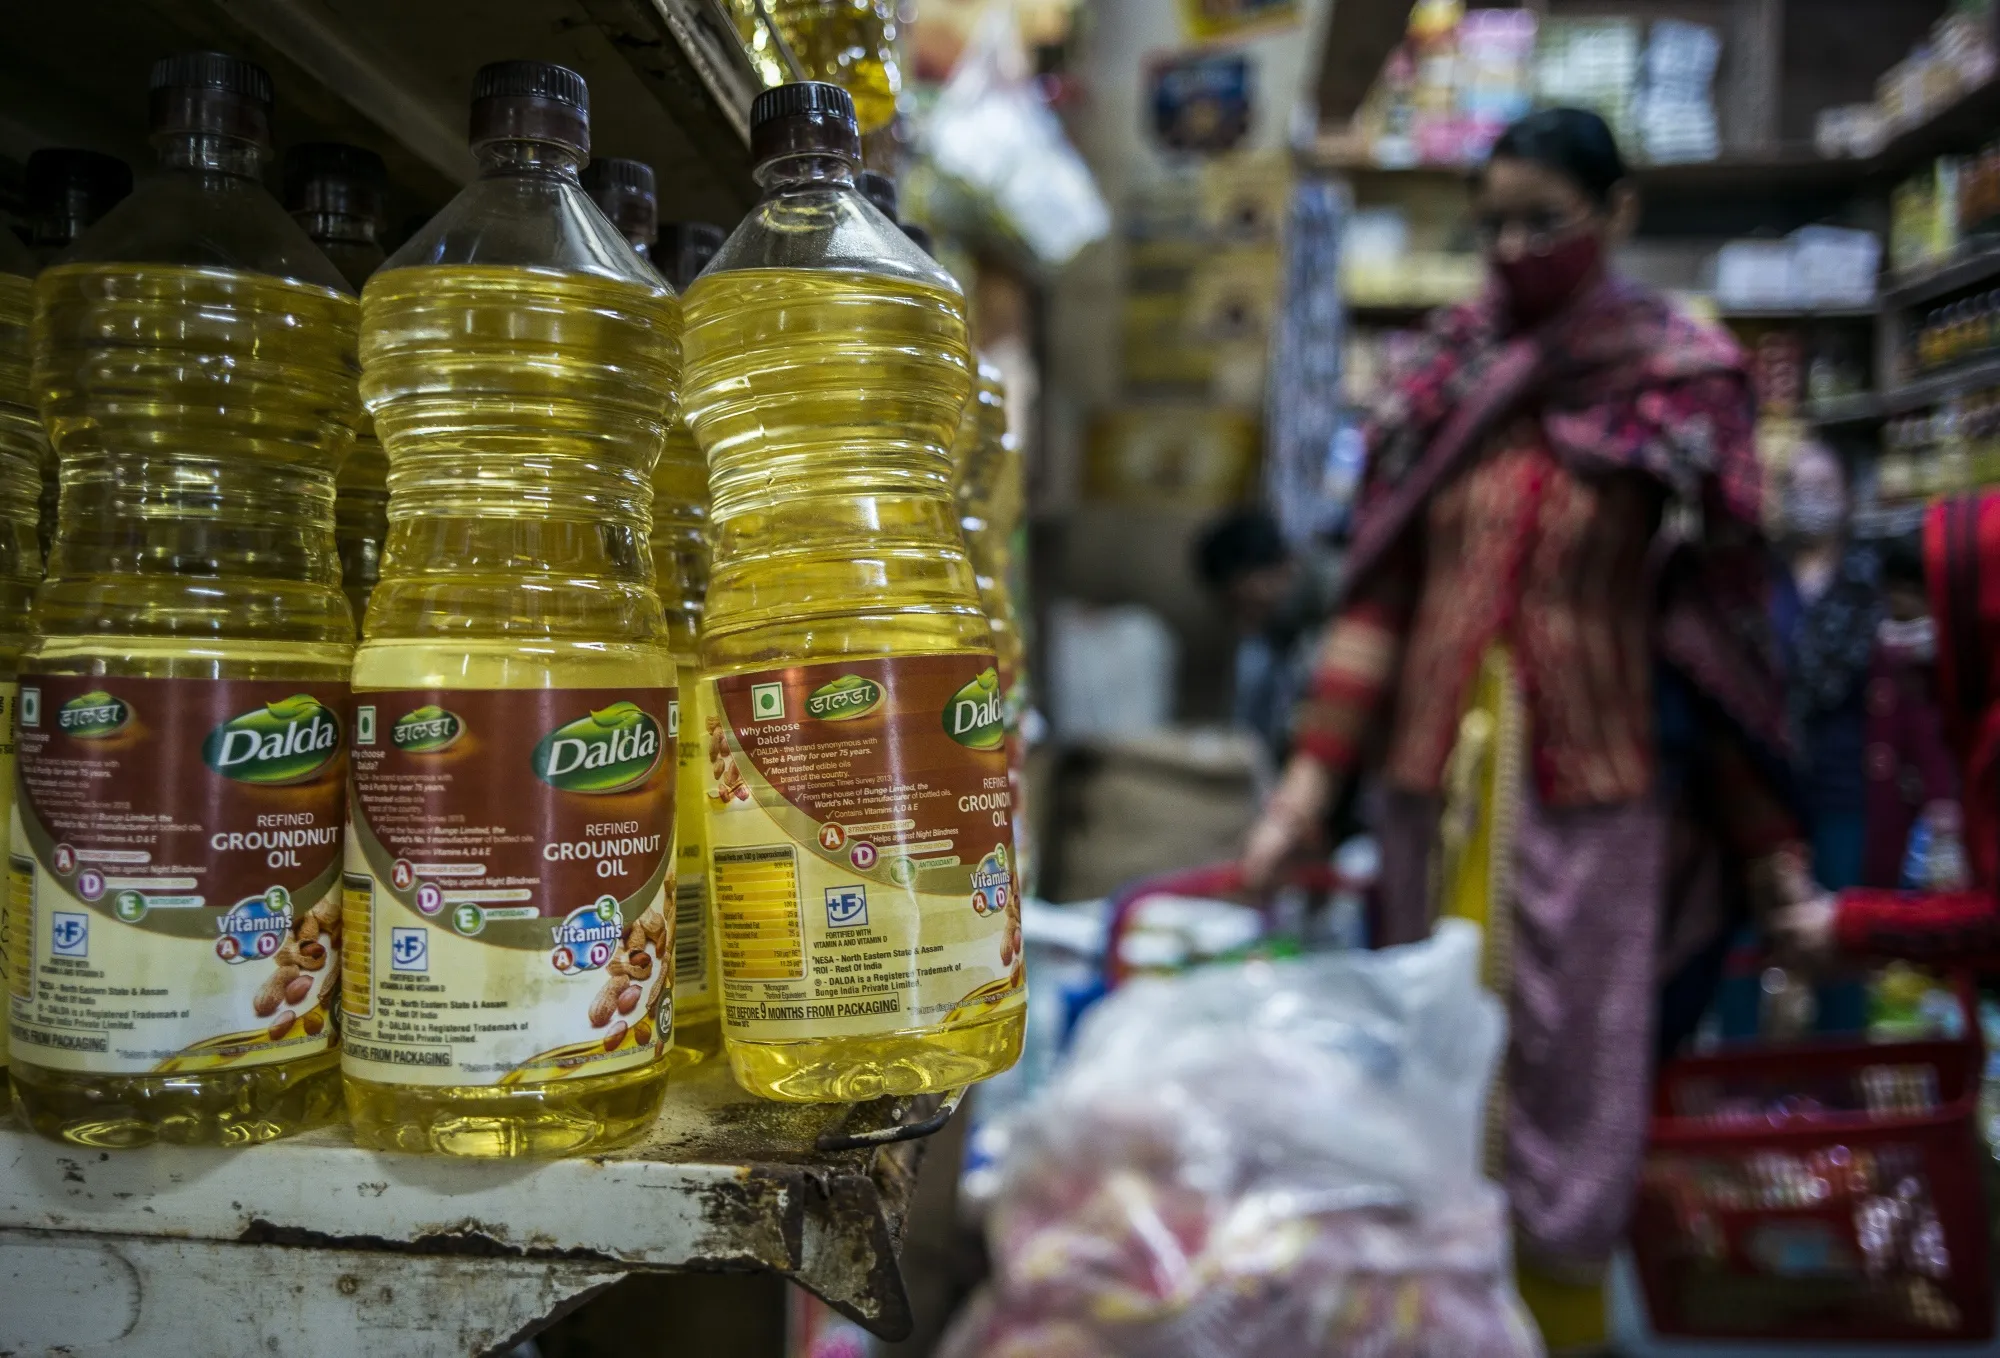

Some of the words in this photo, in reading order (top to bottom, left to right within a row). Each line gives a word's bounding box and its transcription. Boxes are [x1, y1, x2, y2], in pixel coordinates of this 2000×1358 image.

[810, 685, 872, 714] डालडा
[60, 704, 120, 727] डालडा
[394, 718, 452, 743] डालडा
[740, 727, 761, 737] Why
[763, 722, 800, 735] choose
[217, 715, 333, 766] Dalda
[757, 733, 791, 746] Dalda?
[757, 747, 778, 756] DALDA
[783, 745, 795, 753] the
[795, 743, 816, 752] brand
[817, 740, 861, 751] synonymous
[547, 723, 655, 776] Dalda
[762, 756, 779, 765] Taste
[780, 755, 786, 763] &
[787, 753, 807, 762] Purity
[809, 752, 819, 760] for
[821, 751, 837, 759] over
[839, 749, 848, 757] 75
[849, 747, 872, 758] years.
[771, 766, 787, 775] Most
[789, 765, 815, 773] trusted
[816, 762, 837, 770] edible
[838, 760, 851, 768] oils
[781, 775, 799, 784] brand
[822, 770, 850, 780] country.
[807, 780, 836, 790] Economic
[836, 779, 854, 787] Times
[855, 776, 876, 786] Survey
[803, 792, 820, 801] From
[821, 792, 833, 800] the
[833, 790, 855, 799] house
[855, 788, 863, 796] of
[864, 787, 887, 797] Bunge
[814, 799, 841, 809] World's
[843, 798, 855, 807] No.
[862, 794, 910, 804] manufacturer
[911, 792, 919, 800] of
[919, 790, 940, 799] bottled
[941, 789, 952, 797] oils.
[257, 812, 314, 827] REFINED
[834, 809, 863, 818] Contains
[864, 806, 892, 816] Vitamins
[992, 811, 1008, 828] OIL
[585, 821, 639, 837] REFINED
[825, 827, 841, 846] A
[848, 824, 881, 834] STRONGER
[916, 829, 932, 839] Night
[933, 828, 959, 837] Blindness
[211, 826, 338, 851] GROUNDNUT
[543, 834, 661, 862] GROUNDNUT
[853, 846, 873, 865] D
[58, 853, 73, 869] A
[267, 850, 302, 869] OIL
[597, 859, 628, 877] OIL
[919, 858, 954, 868] ANTIOXIDANT
[396, 864, 410, 884] A
[970, 869, 1010, 890] Vitamins
[82, 874, 99, 893] D
[119, 896, 137, 915] E
[270, 892, 281, 906] E
[420, 888, 438, 908] D
[975, 895, 985, 909] A
[998, 890, 1005, 904] D
[601, 901, 612, 916] E
[216, 914, 293, 934] Vitamins
[457, 908, 474, 928] E
[551, 922, 622, 944] Vitamins
[825, 929, 855, 939] FORTIFIED
[856, 928, 872, 937] WITH
[221, 942, 234, 956] A
[262, 935, 276, 951] D
[813, 941, 837, 949] VITAMIN
[844, 939, 856, 947] AND
[857, 937, 881, 946] VITAMIN
[557, 953, 570, 967] A
[595, 944, 606, 960] D
[841, 954, 862, 963] North
[864, 951, 892, 961] Eastern
[921, 945, 944, 954] Assam
[829, 976, 855, 986] DALDA
[857, 974, 865, 983] is
[917, 964, 953, 976] Trademark
[954, 962, 962, 972] of
[835, 964, 852, 973] Rest
[854, 963, 862, 971] Of
[863, 961, 882, 970] India
[815, 988, 838, 997] Bunge
[840, 985, 859, 994] India
[862, 983, 889, 992] Private
[450, 1000, 470, 1009] State
[737, 1006, 760, 1018] BEFORE
[760, 1002, 766, 1019] 9
[768, 1006, 804, 1019] MONTHS
[806, 1005, 835, 1018] FROM
[837, 998, 898, 1017] PACKAGING
[428, 1022, 471, 1033] Registered
[473, 1022, 518, 1032] Trademark
[520, 1021, 529, 1031] of
[52, 1032, 107, 1051] PACKAGING
[370, 1047, 392, 1061] FROM
[394, 1049, 450, 1065] PACKAGING
